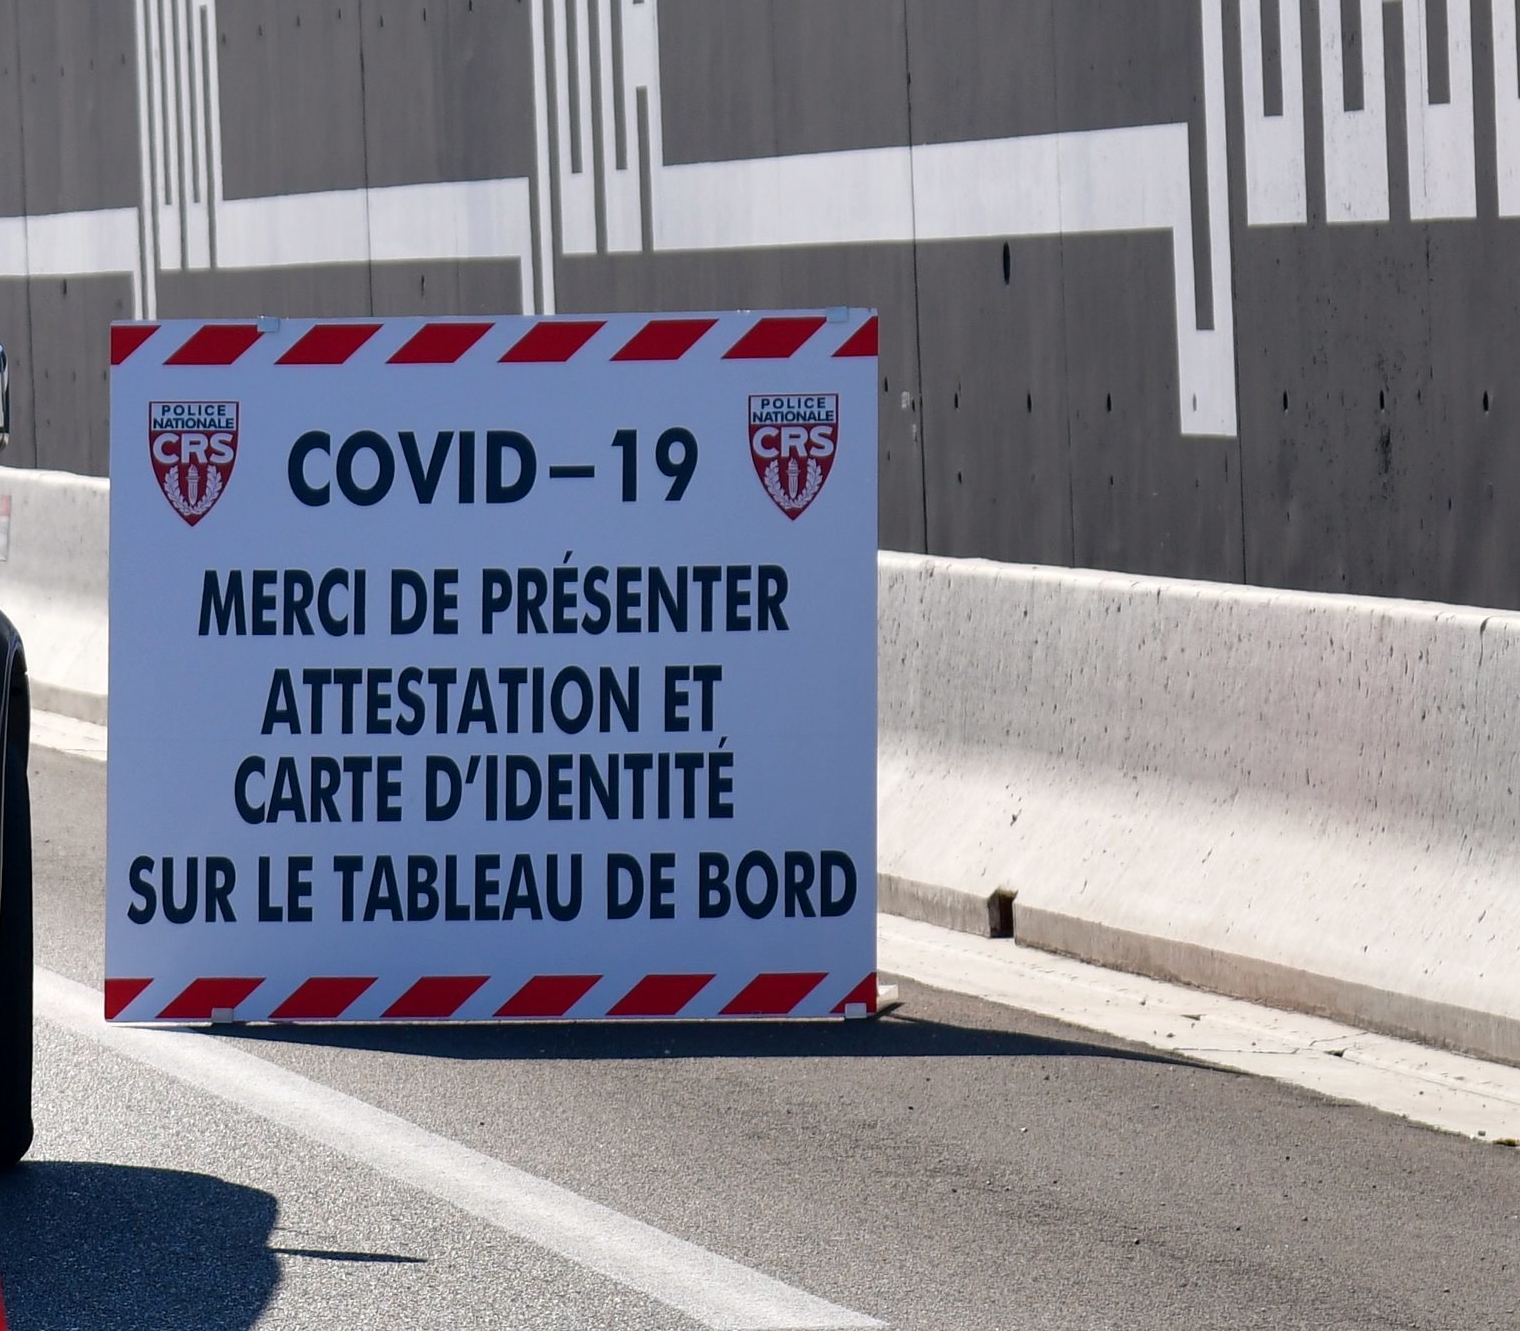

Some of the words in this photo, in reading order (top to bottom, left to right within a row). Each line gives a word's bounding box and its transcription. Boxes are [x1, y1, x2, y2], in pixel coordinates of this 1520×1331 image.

[162, 404, 226, 416] POLICE
[753, 410, 834, 423] NATIONALE
[761, 397, 826, 410] POLICE
[153, 417, 234, 429] NATIONALE
[153, 432, 234, 464] CRS
[753, 425, 834, 458] CRS
[287, 426, 699, 507] COVID-19
[198, 567, 367, 637] MERCI
[390, 568, 459, 636] DE
[481, 550, 790, 636] PRÉSENTER
[260, 665, 640, 736] ATTESTATION
[664, 664, 723, 733] ET
[234, 755, 403, 825] CARTE
[425, 736, 734, 822] D'IDENTITÉ
[126, 855, 237, 925] SUR
[258, 855, 314, 923] LE
[333, 853, 583, 923] TABLEAU
[606, 852, 676, 921] DE
[698, 849, 858, 920] BORD
